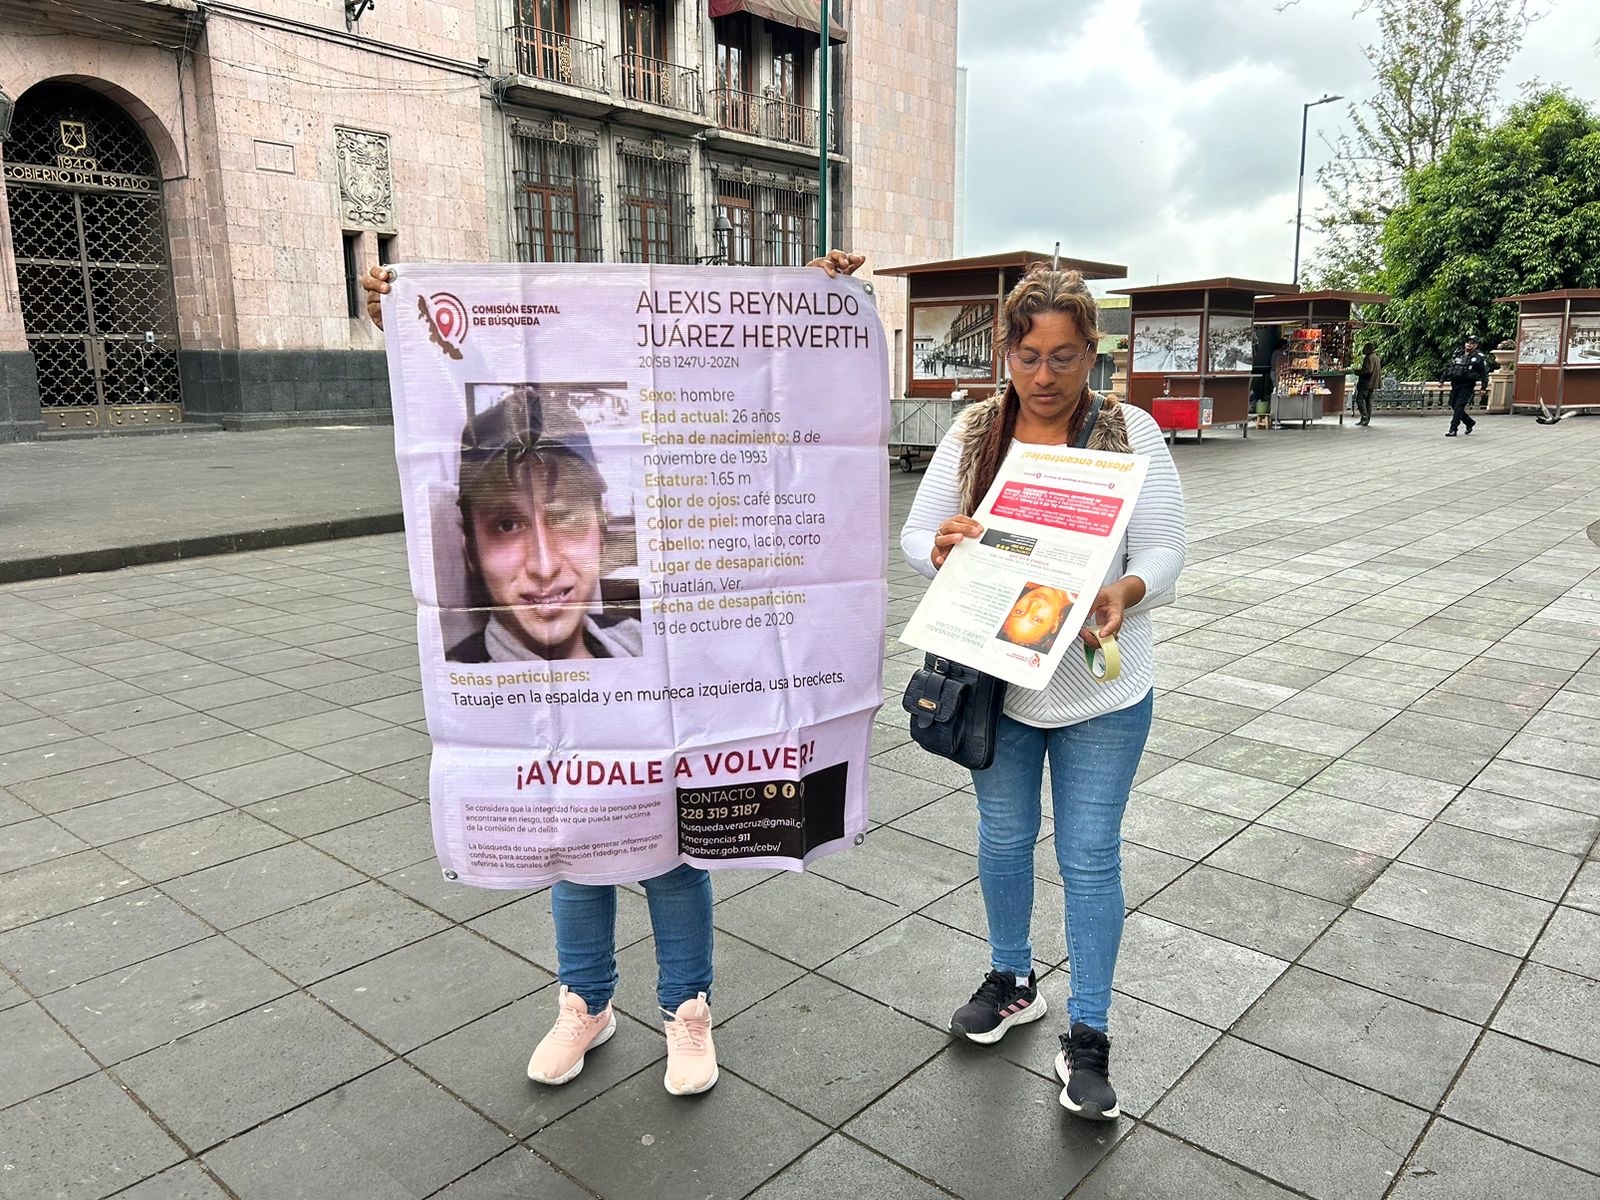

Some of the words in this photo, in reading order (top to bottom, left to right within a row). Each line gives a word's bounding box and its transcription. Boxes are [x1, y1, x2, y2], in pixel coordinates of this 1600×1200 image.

[60, 157, 96, 171] 1940
[4, 166, 70, 183] GOBIERNO
[75, 176, 98, 185] DEL
[102, 176, 150, 190] ESTADO
[472, 303, 519, 314] COMISIÓN
[521, 305, 560, 314] ESTATAL
[636, 291, 721, 314] ALEXIS
[730, 292, 859, 316] REYNALDO
[473, 317, 486, 326] DE
[488, 315, 540, 326] BÚSQUEDA
[637, 319, 734, 348] JUÁREZ
[743, 325, 869, 348] HERVERTH
[674, 356, 739, 368] 1247U-20ZN
[640, 389, 676, 402] Sexo:
[680, 388, 735, 402] hombre
[641, 410, 676, 424] Edad
[681, 409, 728, 423] actual:
[732, 409, 748, 423] 26
[751, 410, 780, 423] años
[642, 431, 684, 445] Fecha
[688, 431, 705, 444] de
[710, 430, 789, 444] nacimiento:
[792, 430, 801, 443] 8
[804, 430, 821, 443] de
[643, 451, 716, 466] noviembre
[720, 451, 737, 464] de
[741, 450, 767, 464] 1993
[644, 474, 707, 487] Estatura:
[711, 472, 735, 486] 1.65
[739, 473, 751, 485] m
[646, 494, 681, 509] Color
[687, 493, 704, 507] de
[708, 493, 740, 510] ojos:
[744, 491, 770, 506] café
[774, 492, 816, 505] oscuro
[647, 516, 683, 530] Color
[688, 514, 704, 528] de
[709, 513, 738, 530] piel:
[742, 514, 791, 526] morena
[795, 511, 825, 525] clara
[648, 537, 704, 551] Cabello:
[708, 536, 750, 551] negro,
[754, 533, 786, 548] lacio,
[788, 533, 821, 546] corto
[650, 560, 690, 575] Lugar
[694, 557, 711, 571] de
[716, 553, 804, 571] desaparición:
[651, 578, 717, 595] Tihuatlán,
[720, 577, 743, 590] Ver.
[652, 599, 693, 614] Fecha
[697, 596, 714, 610] de
[719, 590, 806, 610] desaparición:
[653, 622, 666, 635] 19
[669, 620, 687, 635] de
[690, 617, 742, 633] octubre
[745, 614, 761, 628] de
[765, 611, 794, 627] 2020
[449, 672, 493, 686] Señas
[497, 670, 590, 688] particulares:
[451, 691, 504, 708] Tatuaje
[507, 692, 526, 704] en
[530, 690, 541, 703] la
[545, 689, 599, 705] espalda
[602, 691, 611, 705] y
[615, 690, 633, 702] en
[637, 686, 694, 702] muñeca
[698, 678, 765, 698] izquierda,
[769, 678, 789, 690] usa
[793, 671, 845, 688] breckets.
[517, 754, 664, 790] ¡AYÚDALE
[674, 756, 693, 778] A
[704, 740, 815, 776] VOLVER!
[681, 787, 756, 804] CONTACTO
[465, 804, 474, 812] Se
[475, 804, 509, 812] considera
[533, 805, 568, 814] integridad
[608, 803, 636, 812] persona
[638, 800, 661, 809] puede
[681, 807, 703, 819] 228
[707, 807, 728, 819] 319
[731, 803, 760, 817] 3187
[519, 815, 542, 824] riesgo,
[588, 815, 610, 824] pueda
[484, 824, 515, 832] comisión
[568, 843, 590, 852] puede
[592, 841, 619, 850] generar
[621, 834, 662, 845] información
[681, 833, 736, 845] Emergencias
[738, 833, 751, 842] 911
[593, 848, 629, 857] fidedigna,
[630, 845, 646, 853] favor
